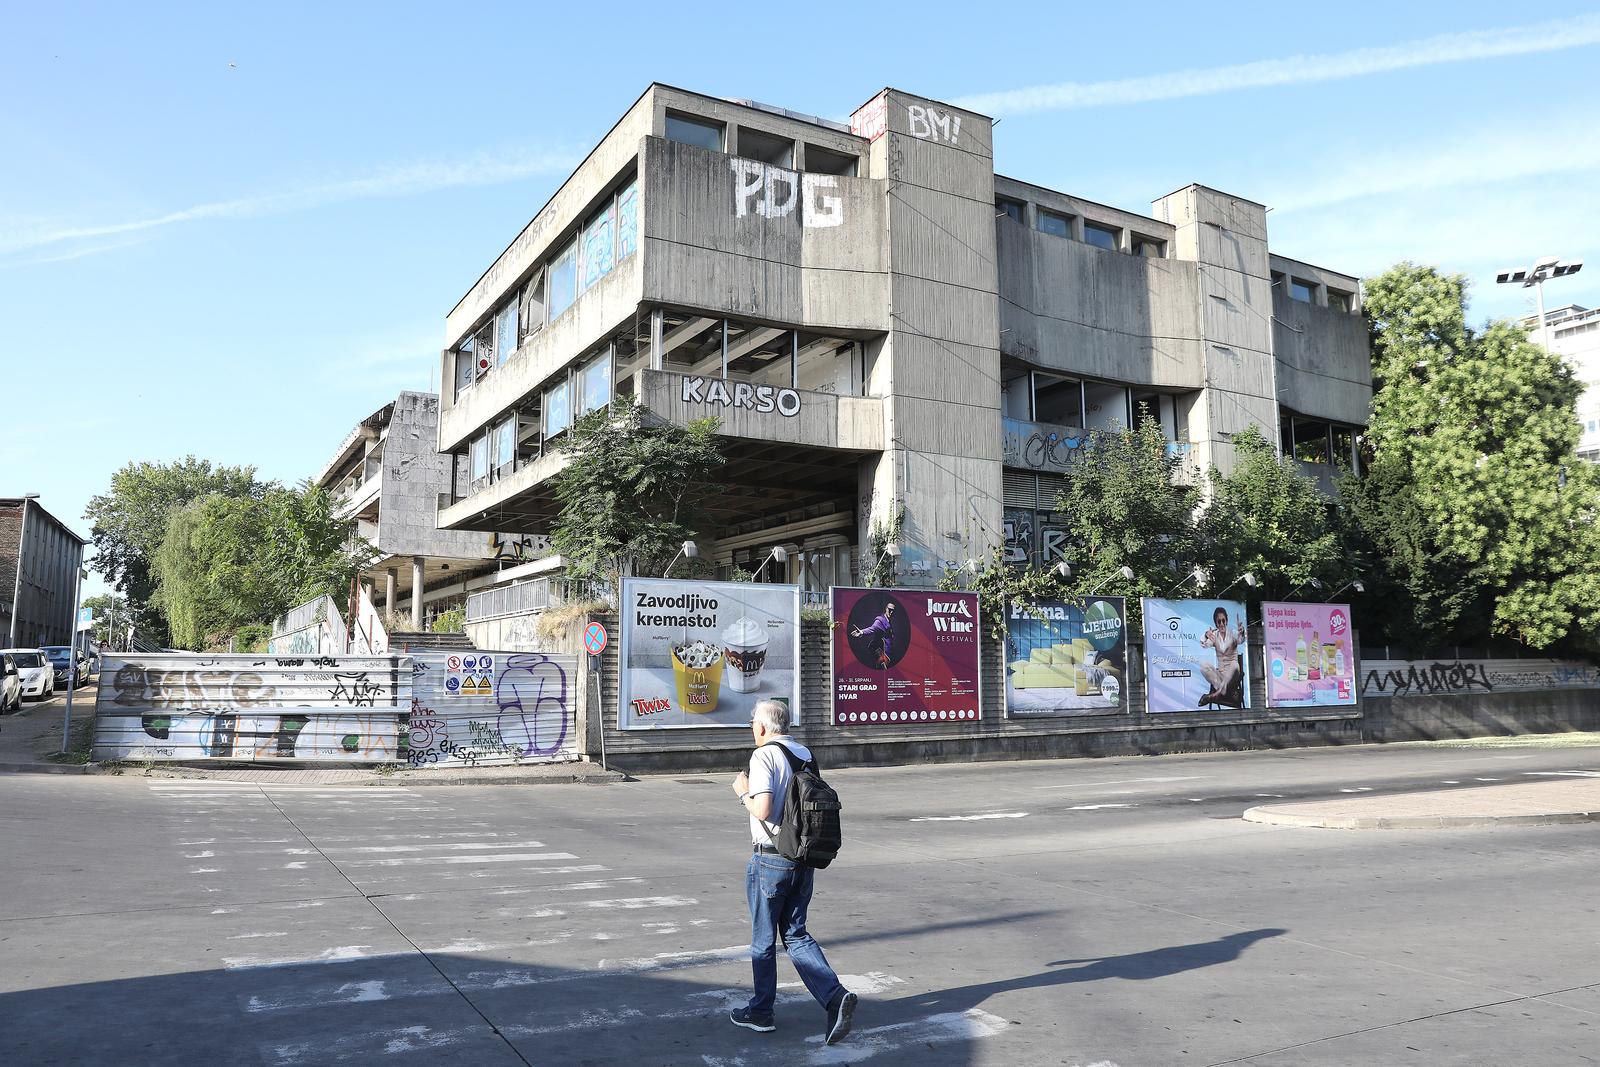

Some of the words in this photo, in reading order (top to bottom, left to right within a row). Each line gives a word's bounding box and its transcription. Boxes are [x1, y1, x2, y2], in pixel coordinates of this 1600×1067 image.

[908, 105, 961, 144] BM!
[731, 159, 843, 228] PDG
[681, 376, 800, 418] KARSO
[637, 593, 718, 613] Zavodljivo
[637, 611, 716, 628] kremasto!
[933, 616, 974, 633] Wine
[1082, 617, 1121, 634] LJETNO
[936, 635, 974, 643] FESTIVAL
[632, 696, 671, 716] Twix
[687, 691, 710, 704] Twix
